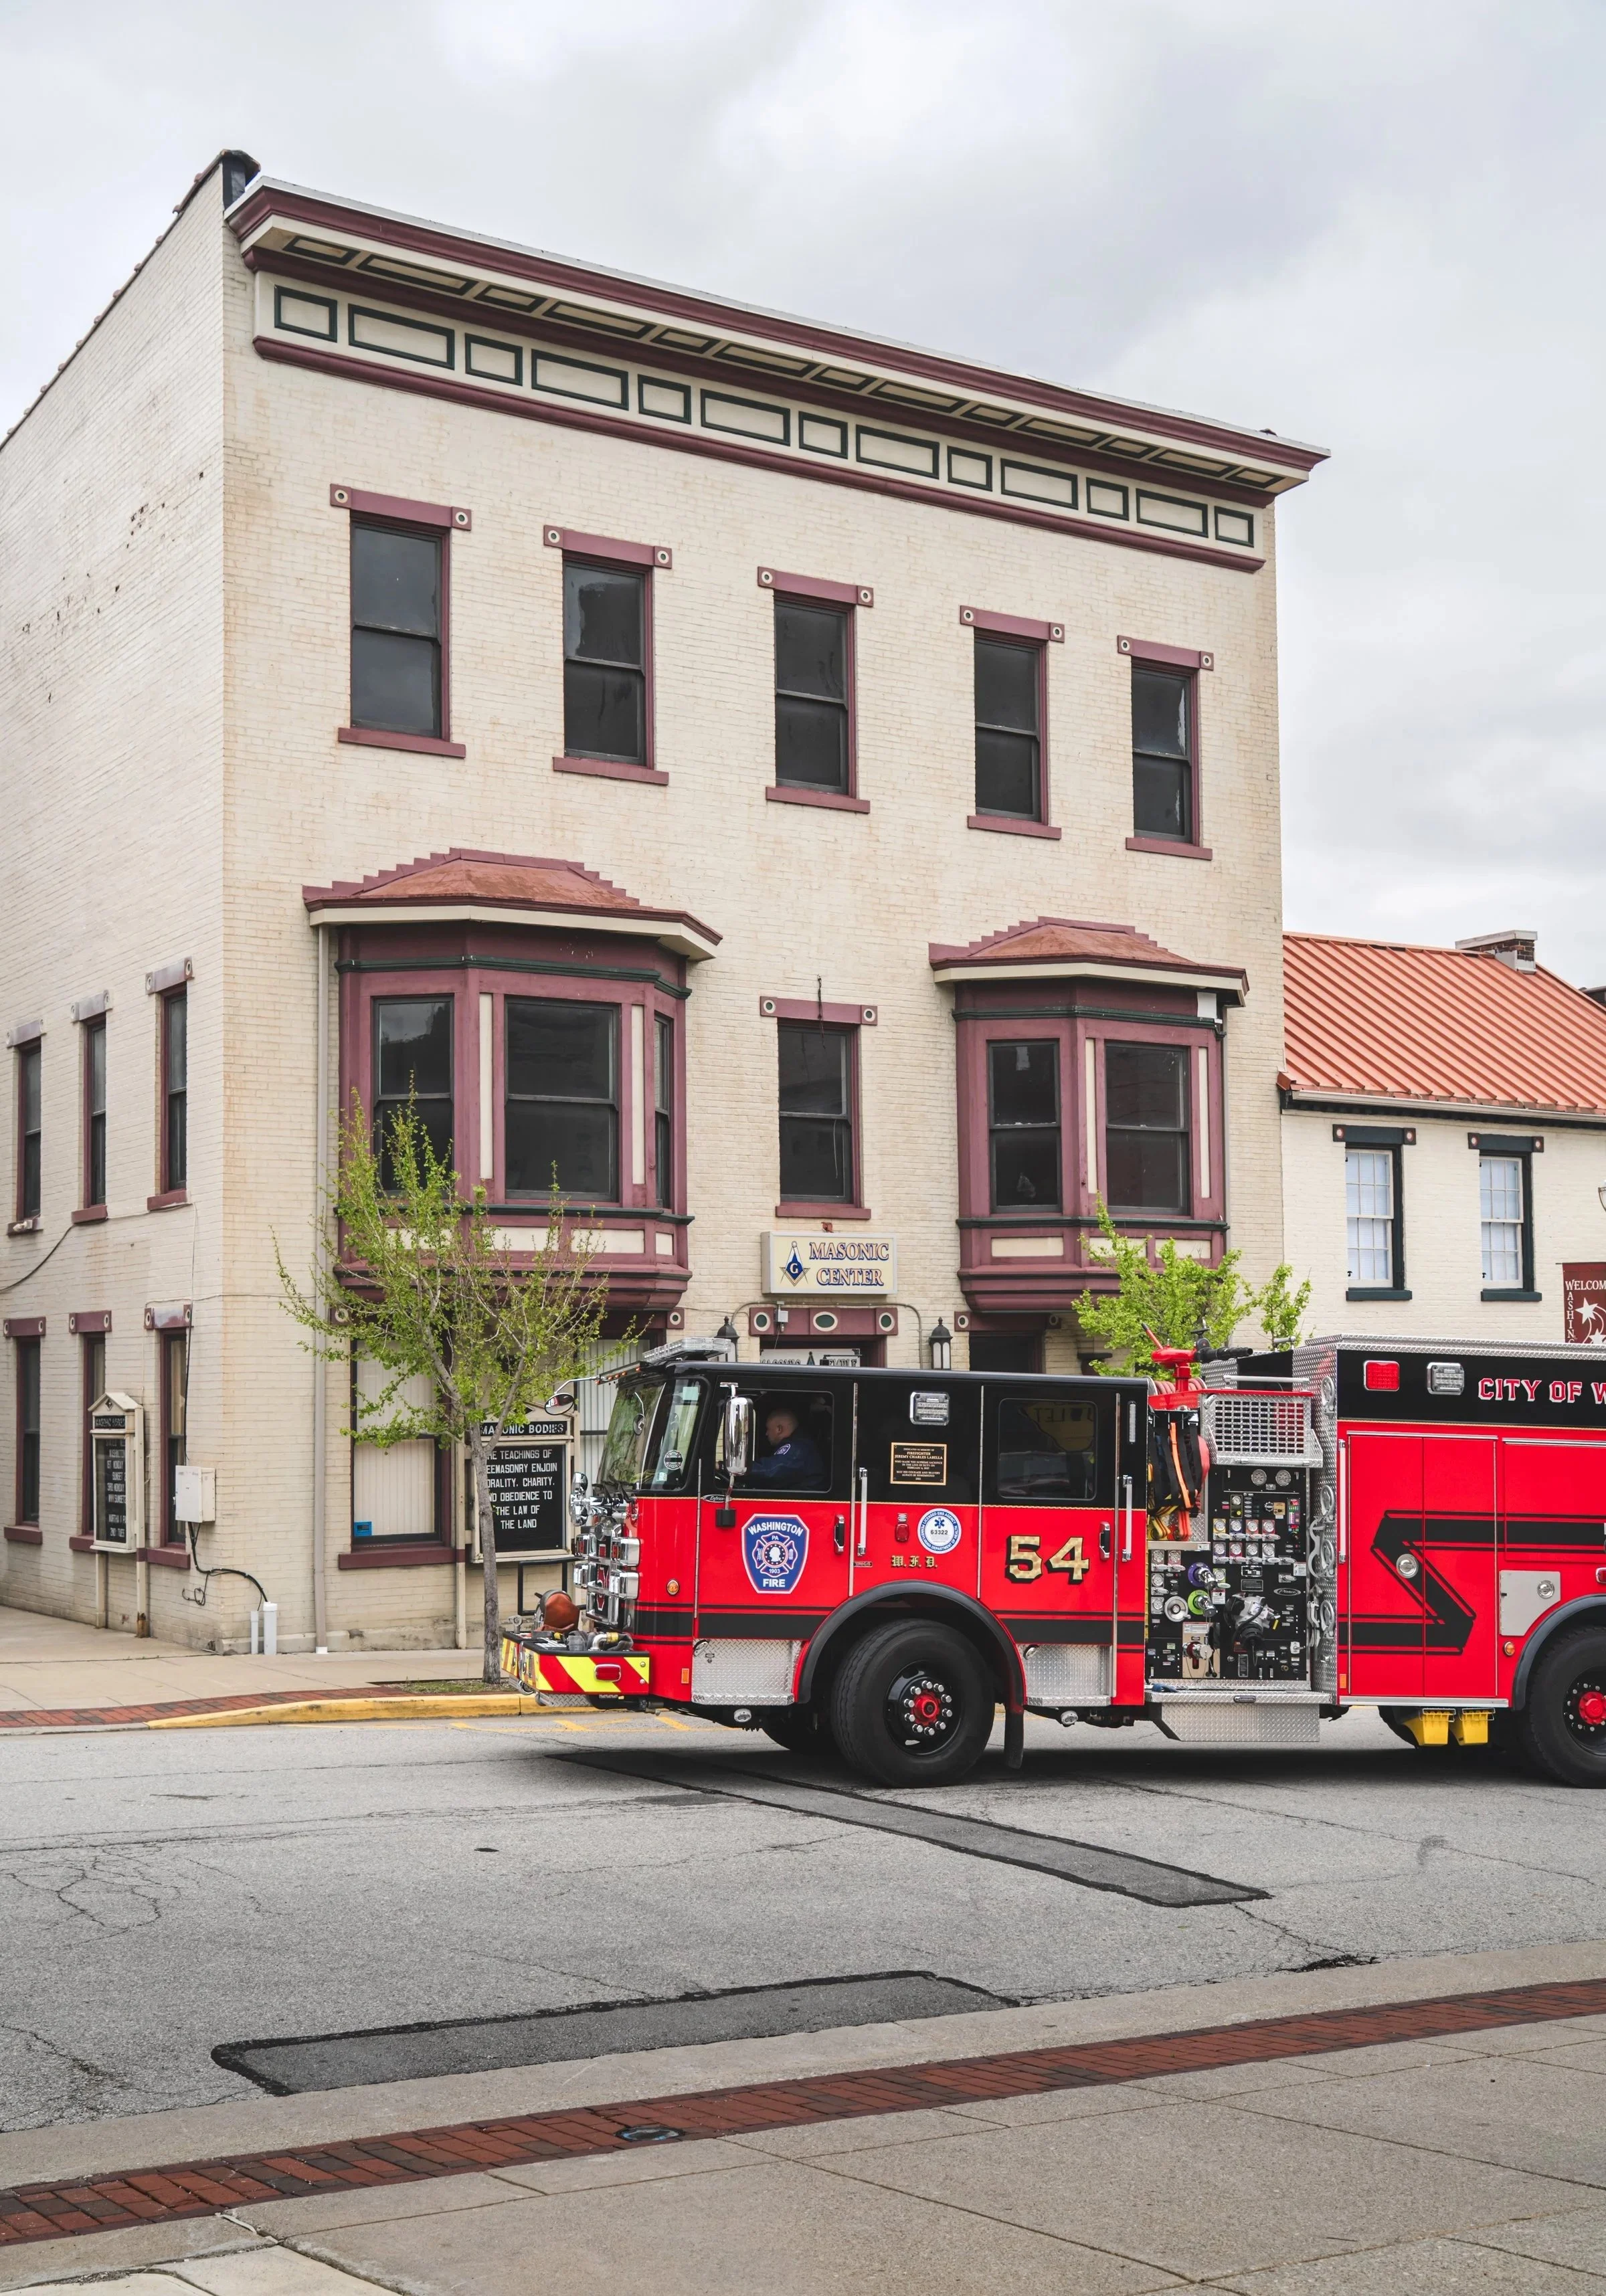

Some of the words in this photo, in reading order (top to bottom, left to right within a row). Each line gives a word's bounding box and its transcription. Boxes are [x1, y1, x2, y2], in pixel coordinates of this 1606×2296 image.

[809, 1242, 889, 1260] MASONIC
[790, 1263, 798, 1274] G
[816, 1268, 884, 1286] CENTER
[1478, 1377, 1542, 1402] CITY
[1549, 1380, 1583, 1404] OF
[480, 1424, 525, 1434] MAONIC
[529, 1424, 563, 1434] BODIES
[487, 1451, 497, 1460] HE
[500, 1450, 540, 1460] TEACHINGS
[543, 1449, 553, 1458] OF
[486, 1464, 529, 1474] EEMASONRY
[531, 1462, 557, 1472] ENJOIN
[488, 1493, 497, 1502] ND
[500, 1491, 540, 1501] OBEDIENCE
[543, 1491, 553, 1500] TO
[495, 1506, 510, 1516] THE
[513, 1505, 528, 1515] LAW
[531, 1505, 540, 1514] OF
[501, 1520, 515, 1529] THE
[518, 1519, 537, 1529] LAND
[747, 1521, 804, 1537] WASHINGTON
[1005, 1535, 1089, 1584] 54
[763, 1578, 786, 1588] FIRE
